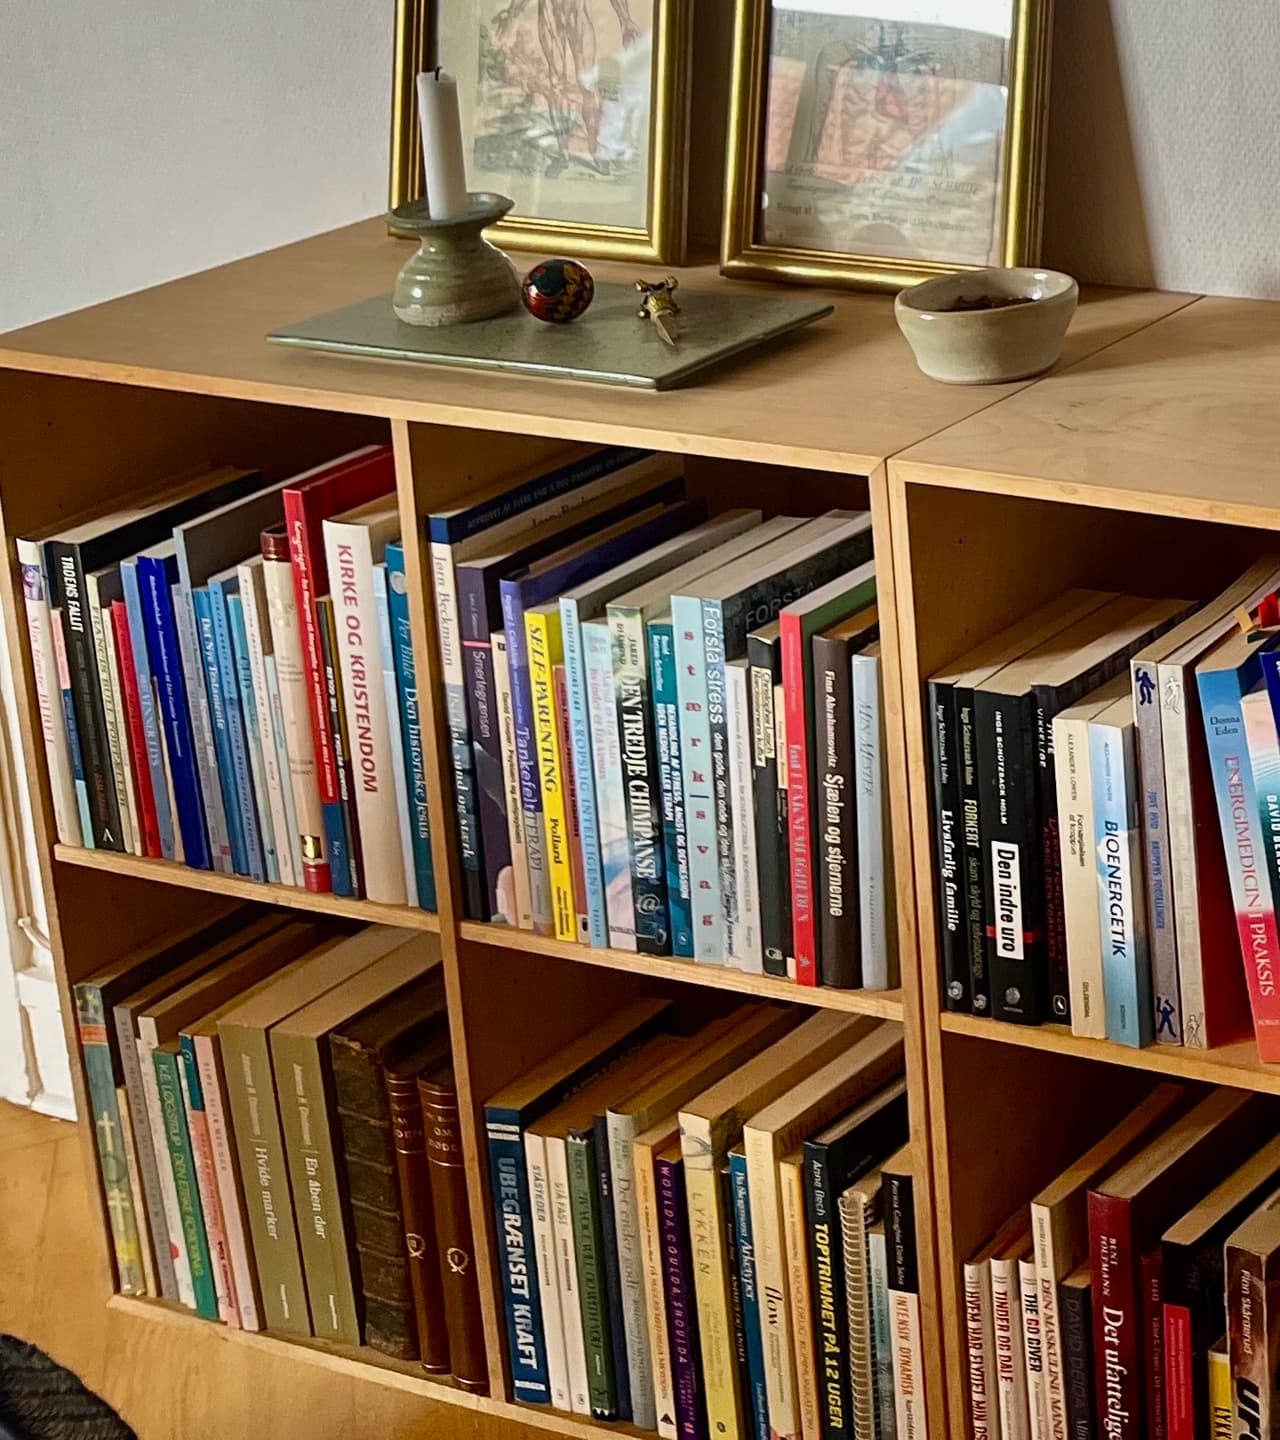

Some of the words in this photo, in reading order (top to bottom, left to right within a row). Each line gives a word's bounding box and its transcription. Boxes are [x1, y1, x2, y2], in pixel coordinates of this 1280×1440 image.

[338, 544, 359, 607] KIRKE
[345, 616, 362, 646] OG
[350, 654, 379, 793] KRISTENDOM
[528, 624, 558, 793] SELF-PARENTING
[824, 774, 843, 822] Sjælen
[826, 825, 840, 846] og
[828, 848, 843, 916] stjernerne
[997, 849, 1012, 879] Den
[999, 883, 1015, 922] indre
[1104, 820, 1126, 958] BIOENERGETIK
[1001, 926, 1016, 953] uro
[1251, 923, 1276, 997] PRAKSIS
[812, 1223, 837, 1329] TOPTRIMMET
[512, 1305, 539, 1370] KRAFT
[822, 1333, 837, 1353] PÅ
[822, 1357, 837, 1380] 12
[822, 1386, 844, 1430] UGER
